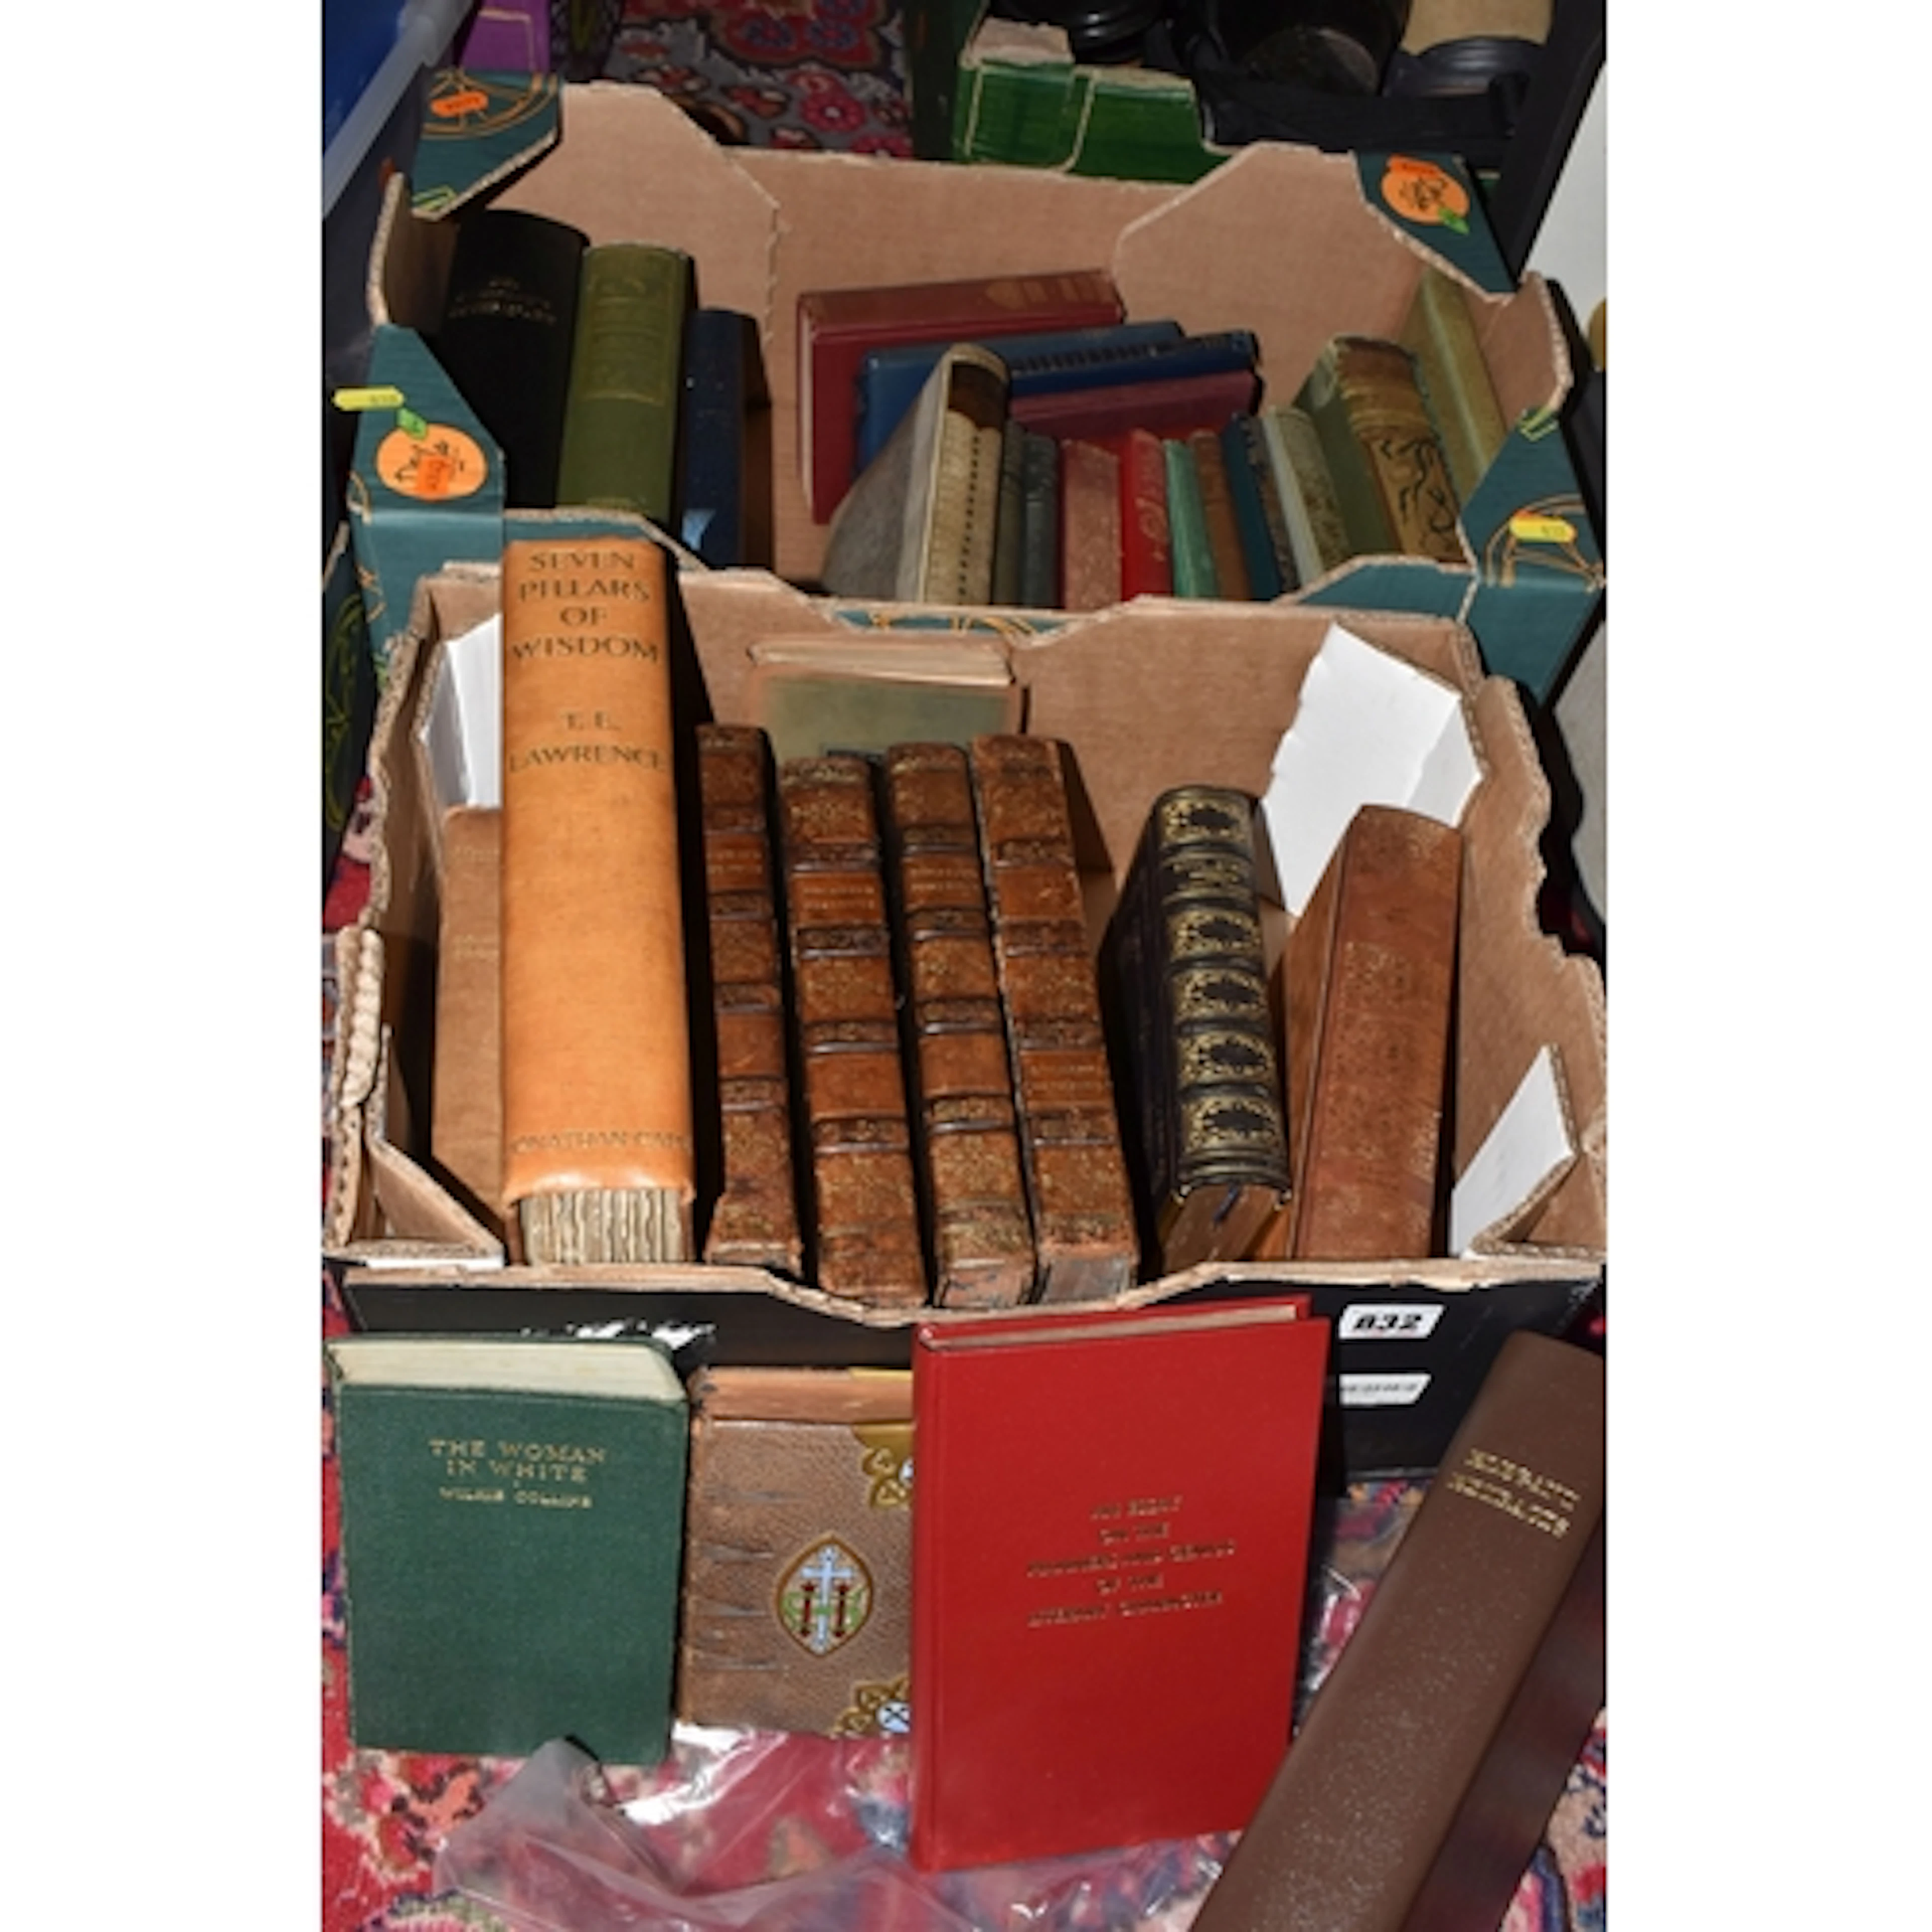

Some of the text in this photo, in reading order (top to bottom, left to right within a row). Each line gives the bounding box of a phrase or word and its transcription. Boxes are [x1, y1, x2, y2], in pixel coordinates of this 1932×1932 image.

[527, 551, 635, 571] SEVEN
[519, 579, 650, 602] PILLARS
[559, 606, 608, 626] OF
[511, 636, 659, 663] WISDOM
[509, 745, 665, 773] LAWRENCE
[428, 1439, 607, 1465] THE WOMAN
[446, 1459, 588, 1484] IN WHITE
